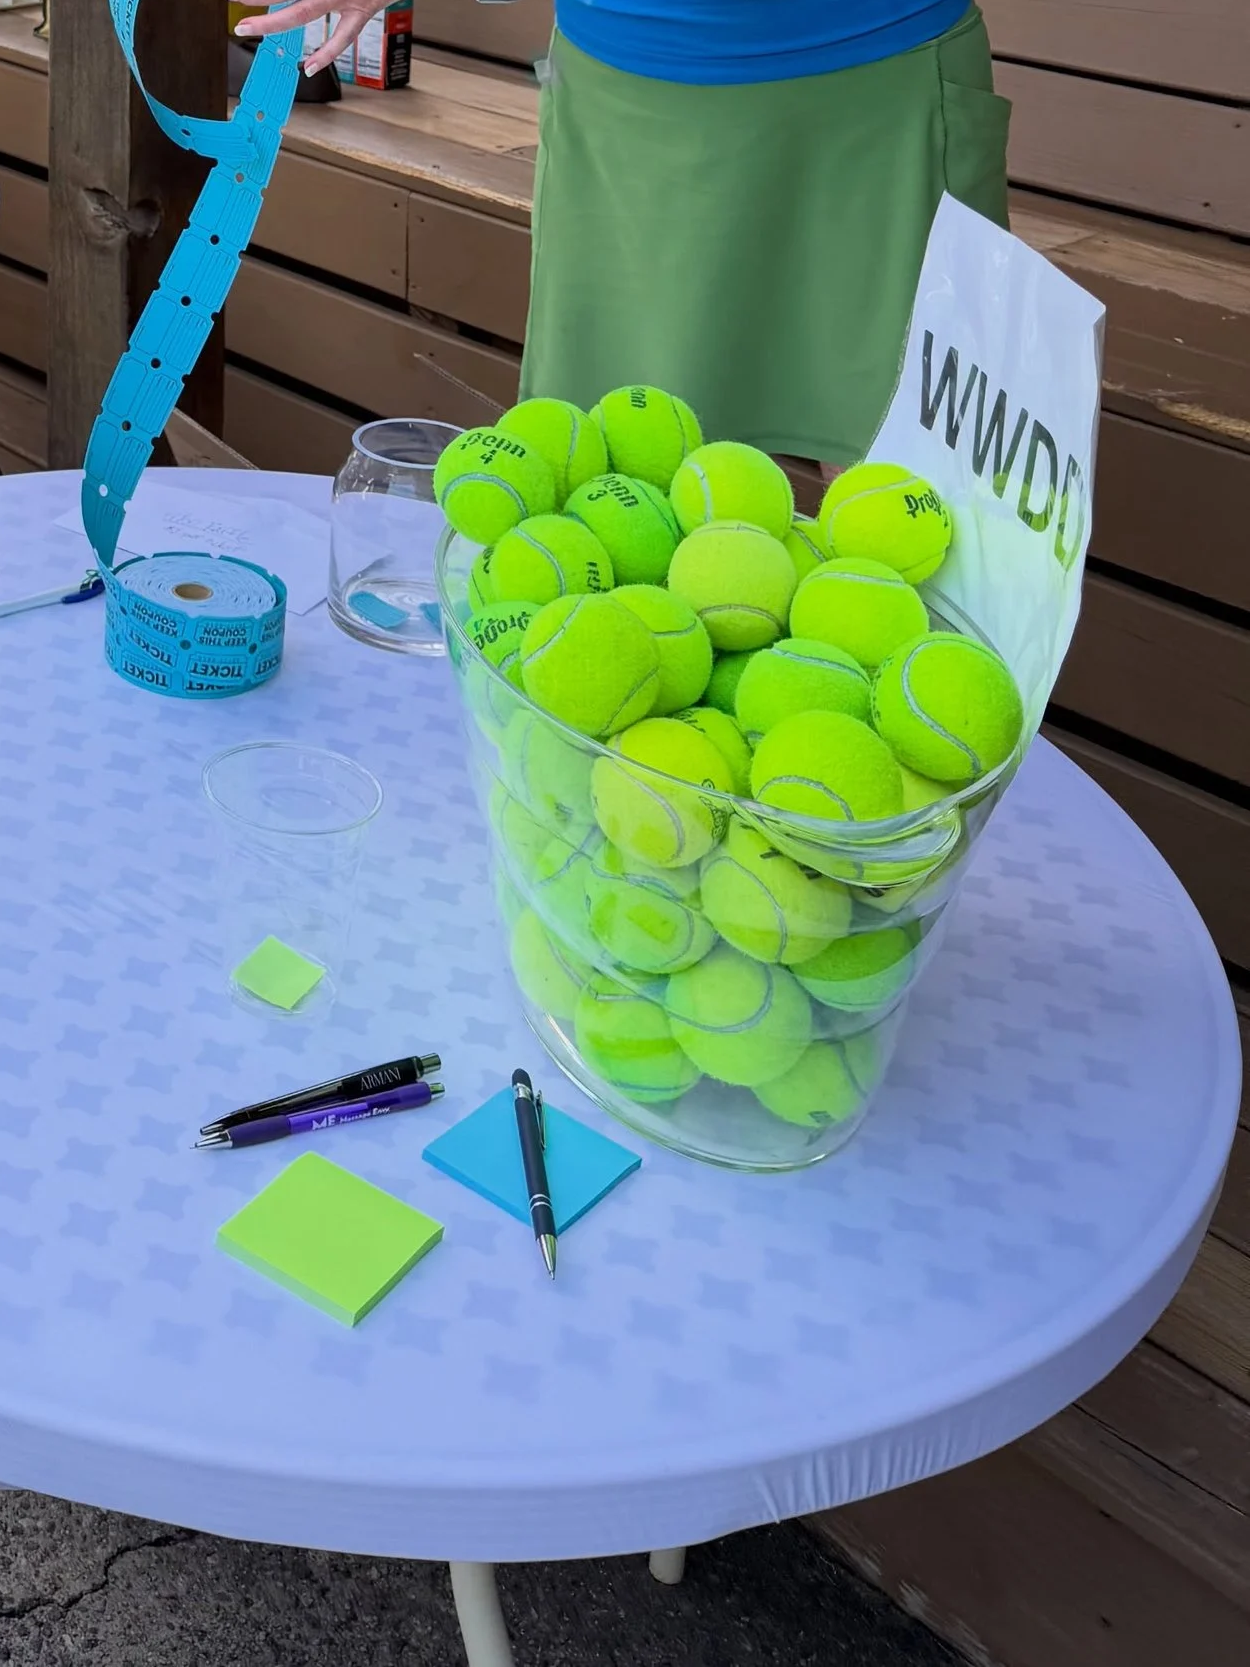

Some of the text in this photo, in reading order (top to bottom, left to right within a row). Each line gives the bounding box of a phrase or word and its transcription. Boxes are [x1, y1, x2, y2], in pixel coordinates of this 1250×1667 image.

[480, 449, 497, 465] 4
[132, 602, 178, 629] COUPON
[153, 623, 178, 638] KEEP
[203, 628, 247, 637] COUPON
[129, 630, 173, 666] TICKET
[199, 636, 247, 647] KEEP THIS
[122, 660, 169, 687] TICKET
[191, 662, 244, 678] TICKET
[361, 1067, 402, 1091] ARMANI
[312, 1114, 336, 1131] ME
